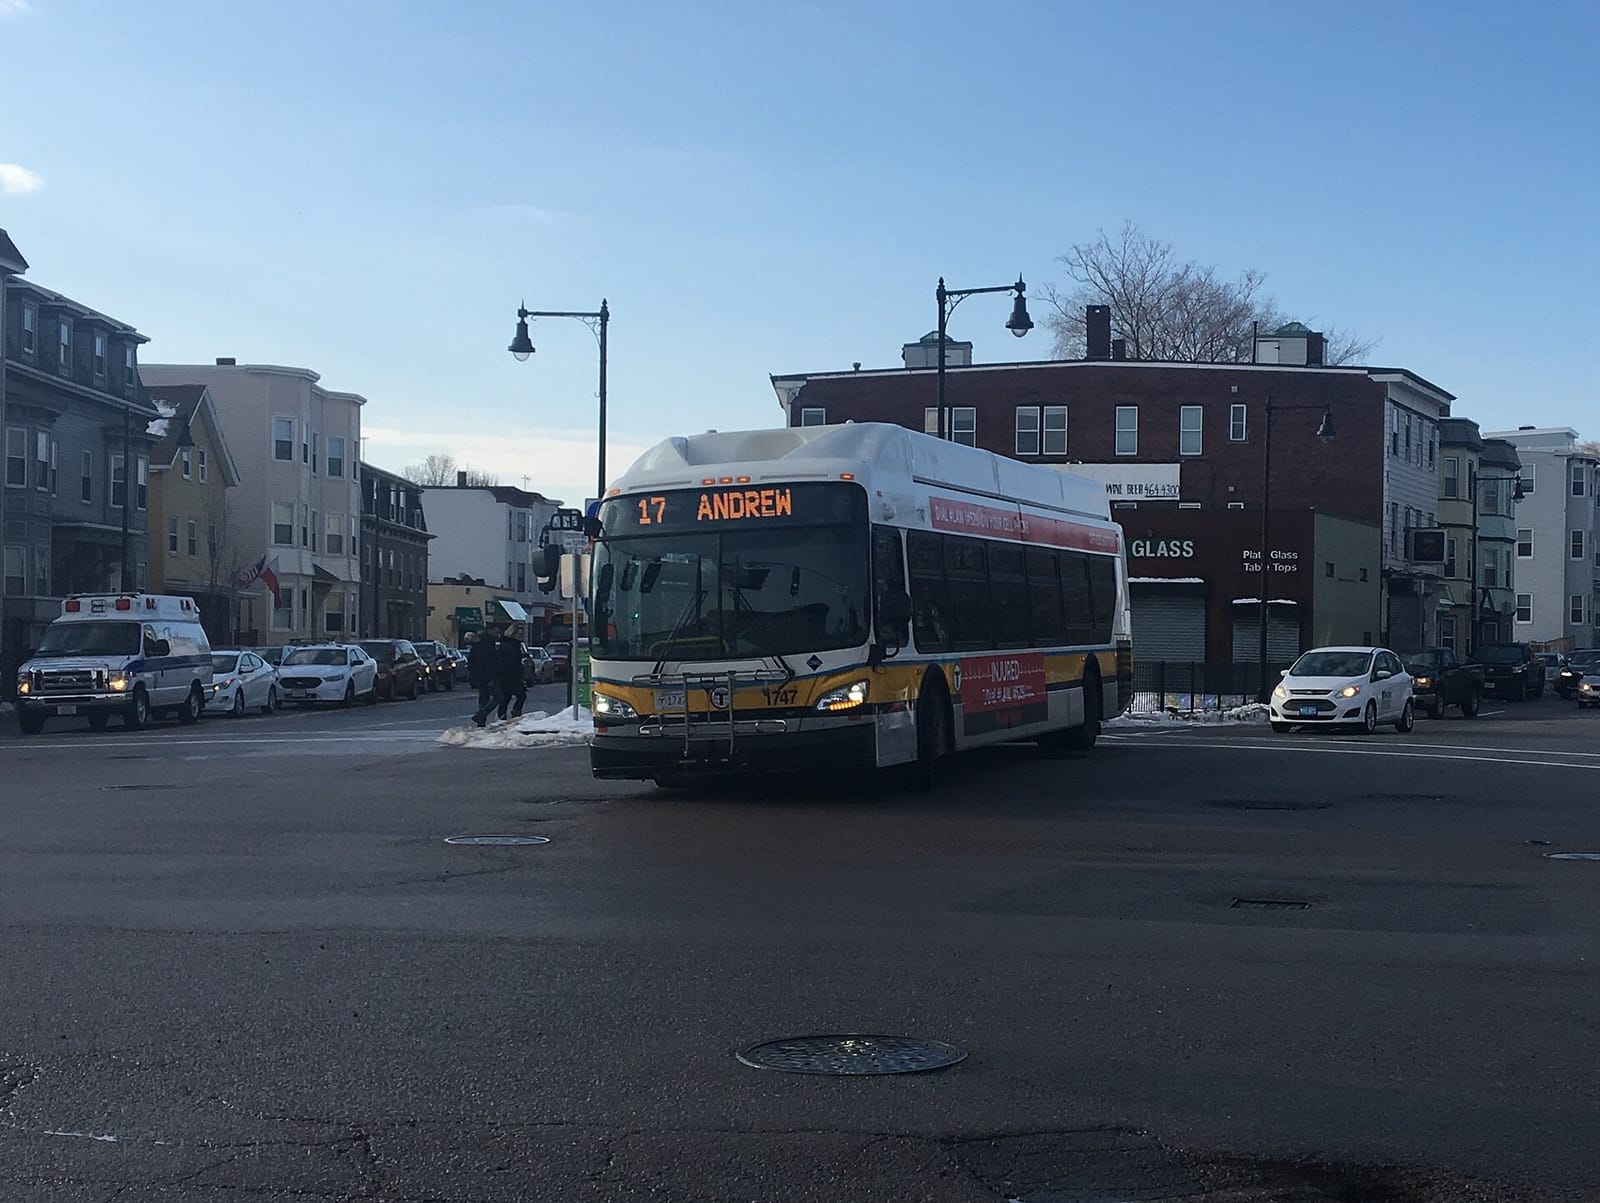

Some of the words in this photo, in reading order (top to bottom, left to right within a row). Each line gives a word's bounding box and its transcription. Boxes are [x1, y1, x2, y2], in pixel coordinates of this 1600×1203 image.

[638, 497, 666, 525] 17
[697, 488, 791, 521] ANDREW
[1132, 540, 1194, 557] GLASS
[1242, 550, 1263, 559] Plat
[1270, 550, 1299, 559] Glass
[1243, 562, 1270, 571] Tab
[1272, 562, 1297, 573] Tops
[763, 687, 798, 707] 1747
